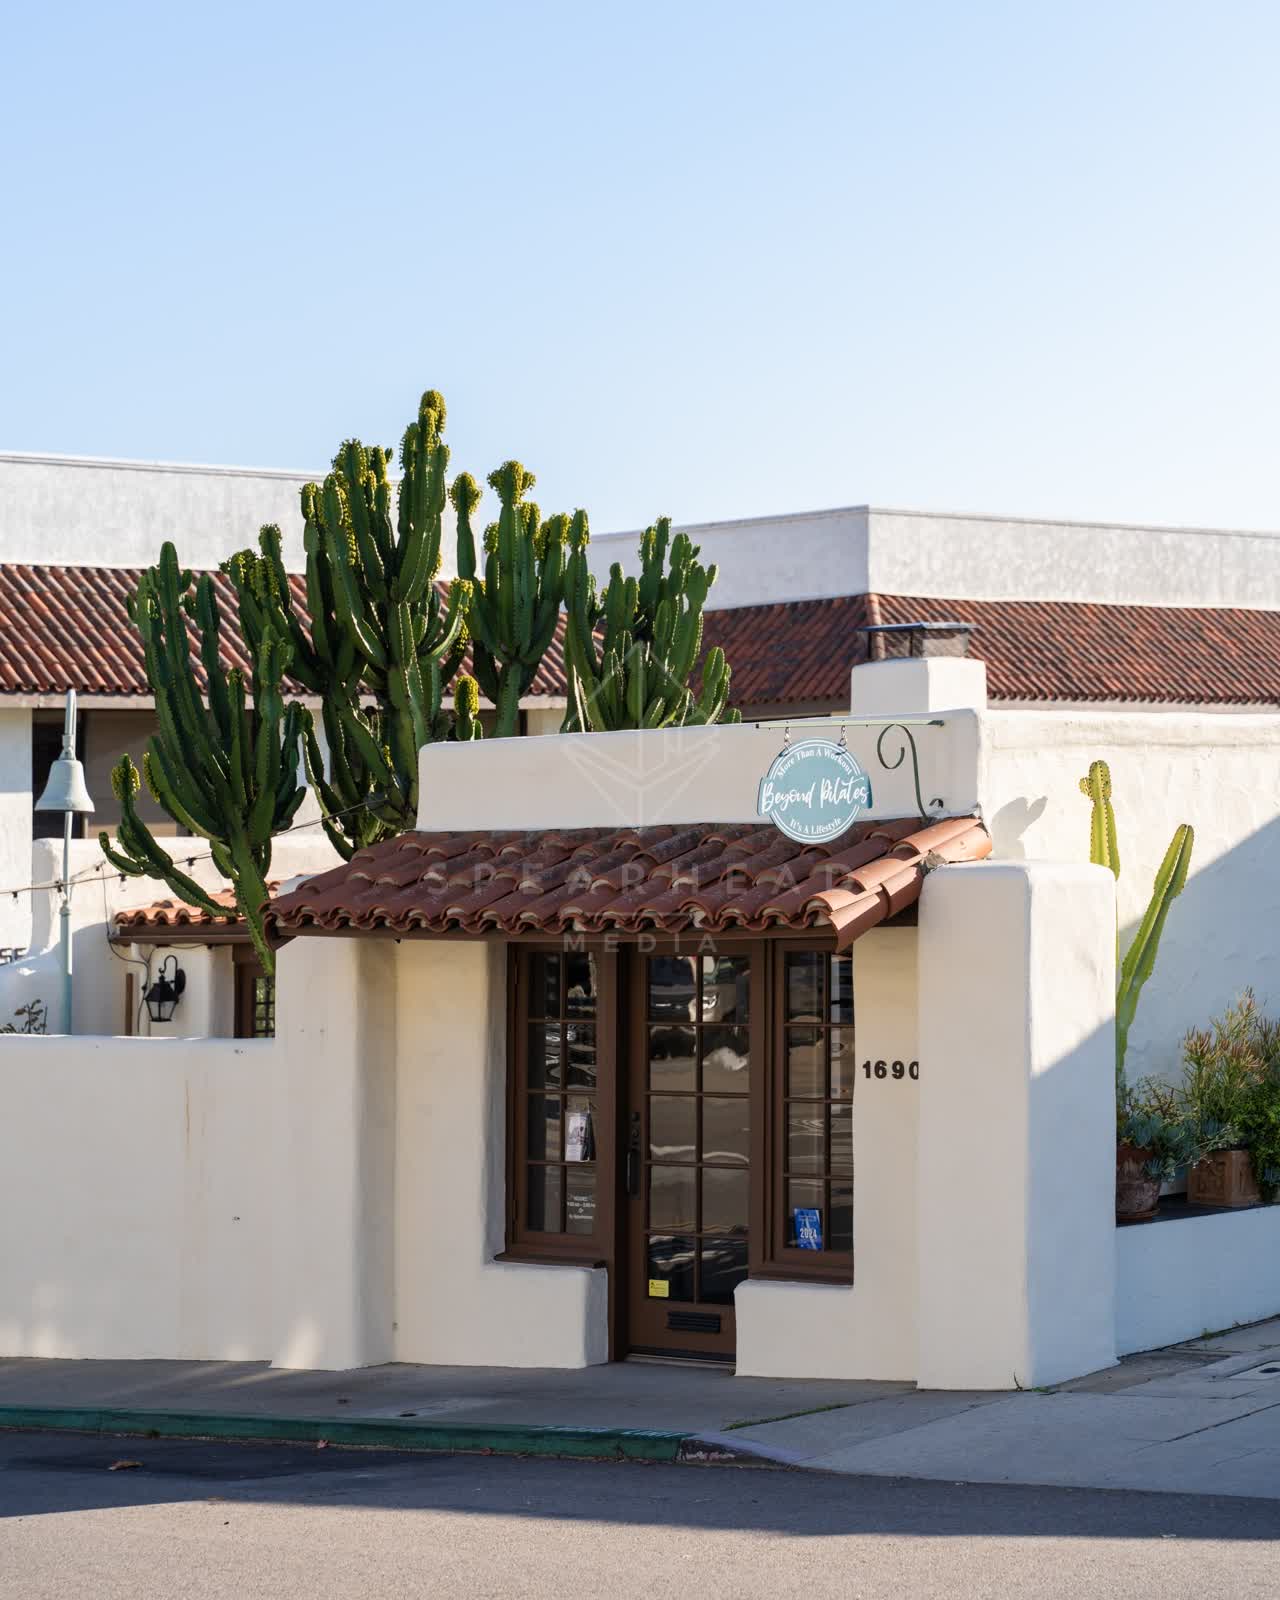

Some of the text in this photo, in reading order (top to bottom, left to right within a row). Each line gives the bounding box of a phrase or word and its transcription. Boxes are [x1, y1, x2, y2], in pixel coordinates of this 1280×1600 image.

[777, 747, 853, 777] More Than A Workout
[761, 776, 869, 814] Beyond Pilates
[803, 824, 809, 835] A
[810, 817, 841, 836] Lifestyle
[862, 1060, 919, 1080] 1690
[800, 1227, 817, 1240] 2024
